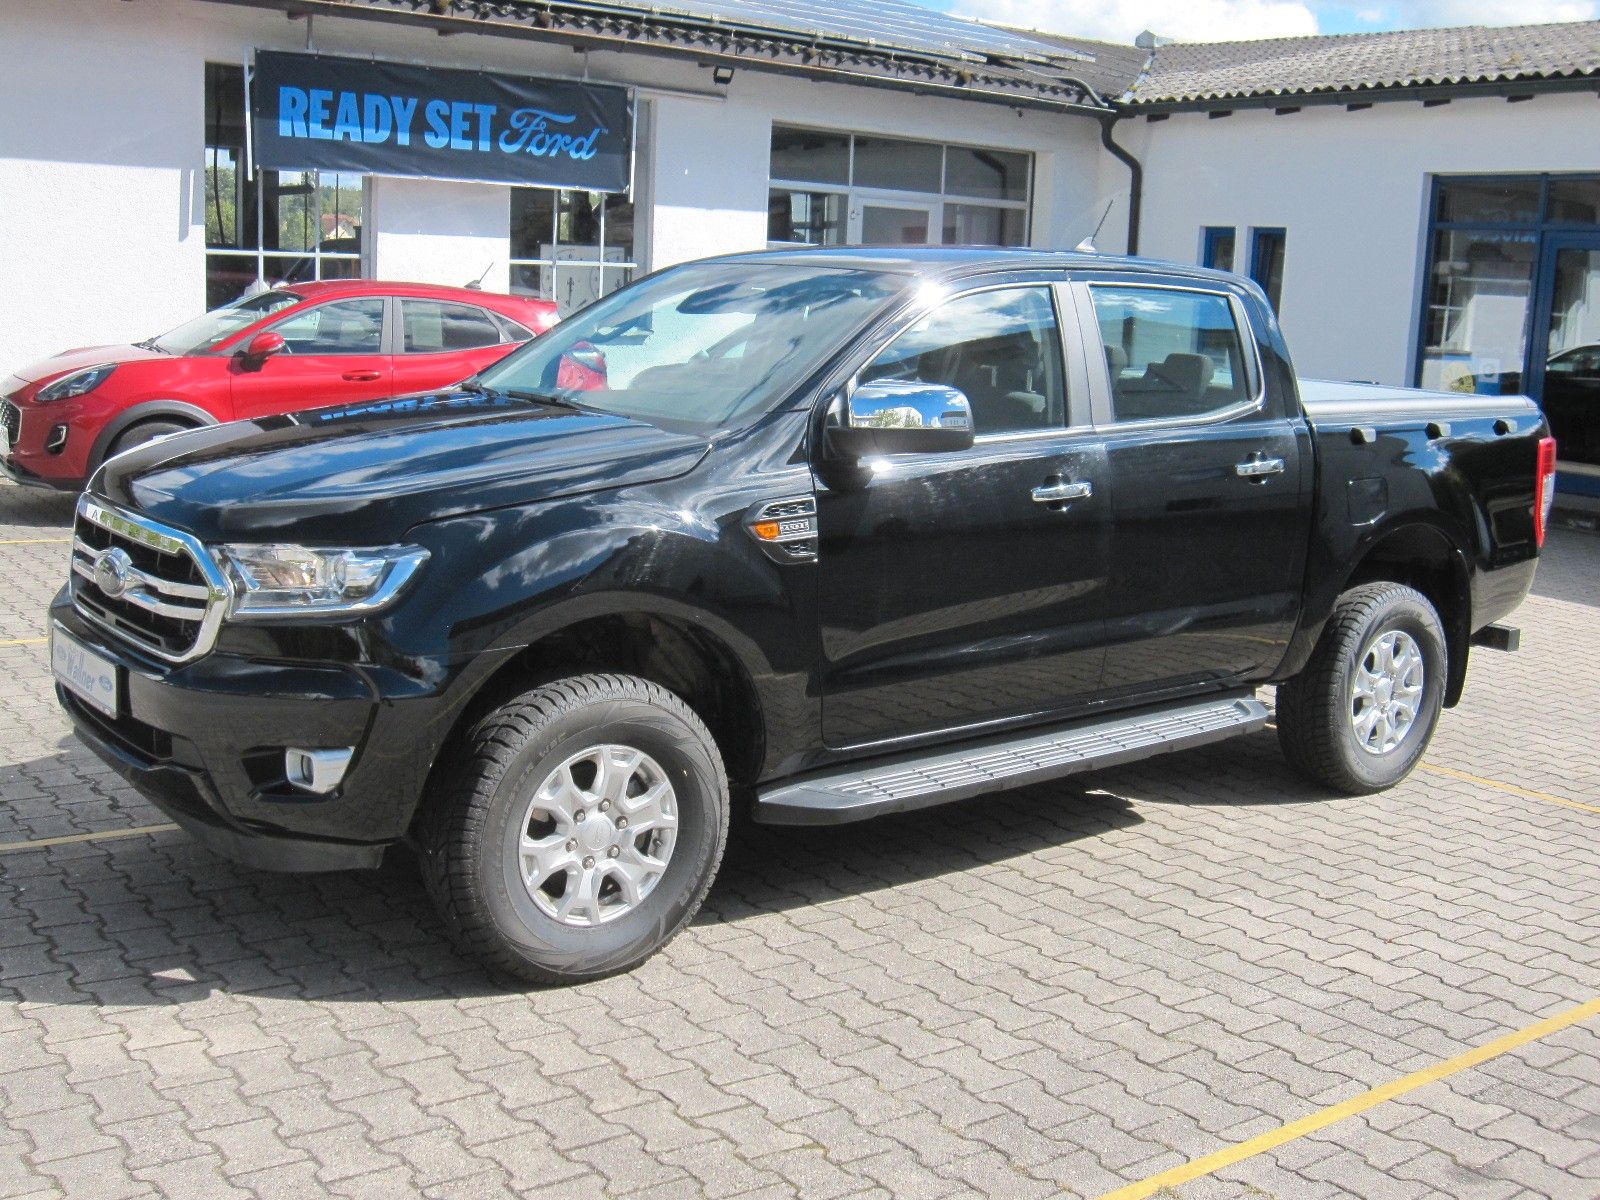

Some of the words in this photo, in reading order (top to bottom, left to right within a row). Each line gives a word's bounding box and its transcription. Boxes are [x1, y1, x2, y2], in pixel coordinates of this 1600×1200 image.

[279, 86, 418, 146] READY
[424, 99, 497, 152] SET
[499, 107, 600, 161] Ford
